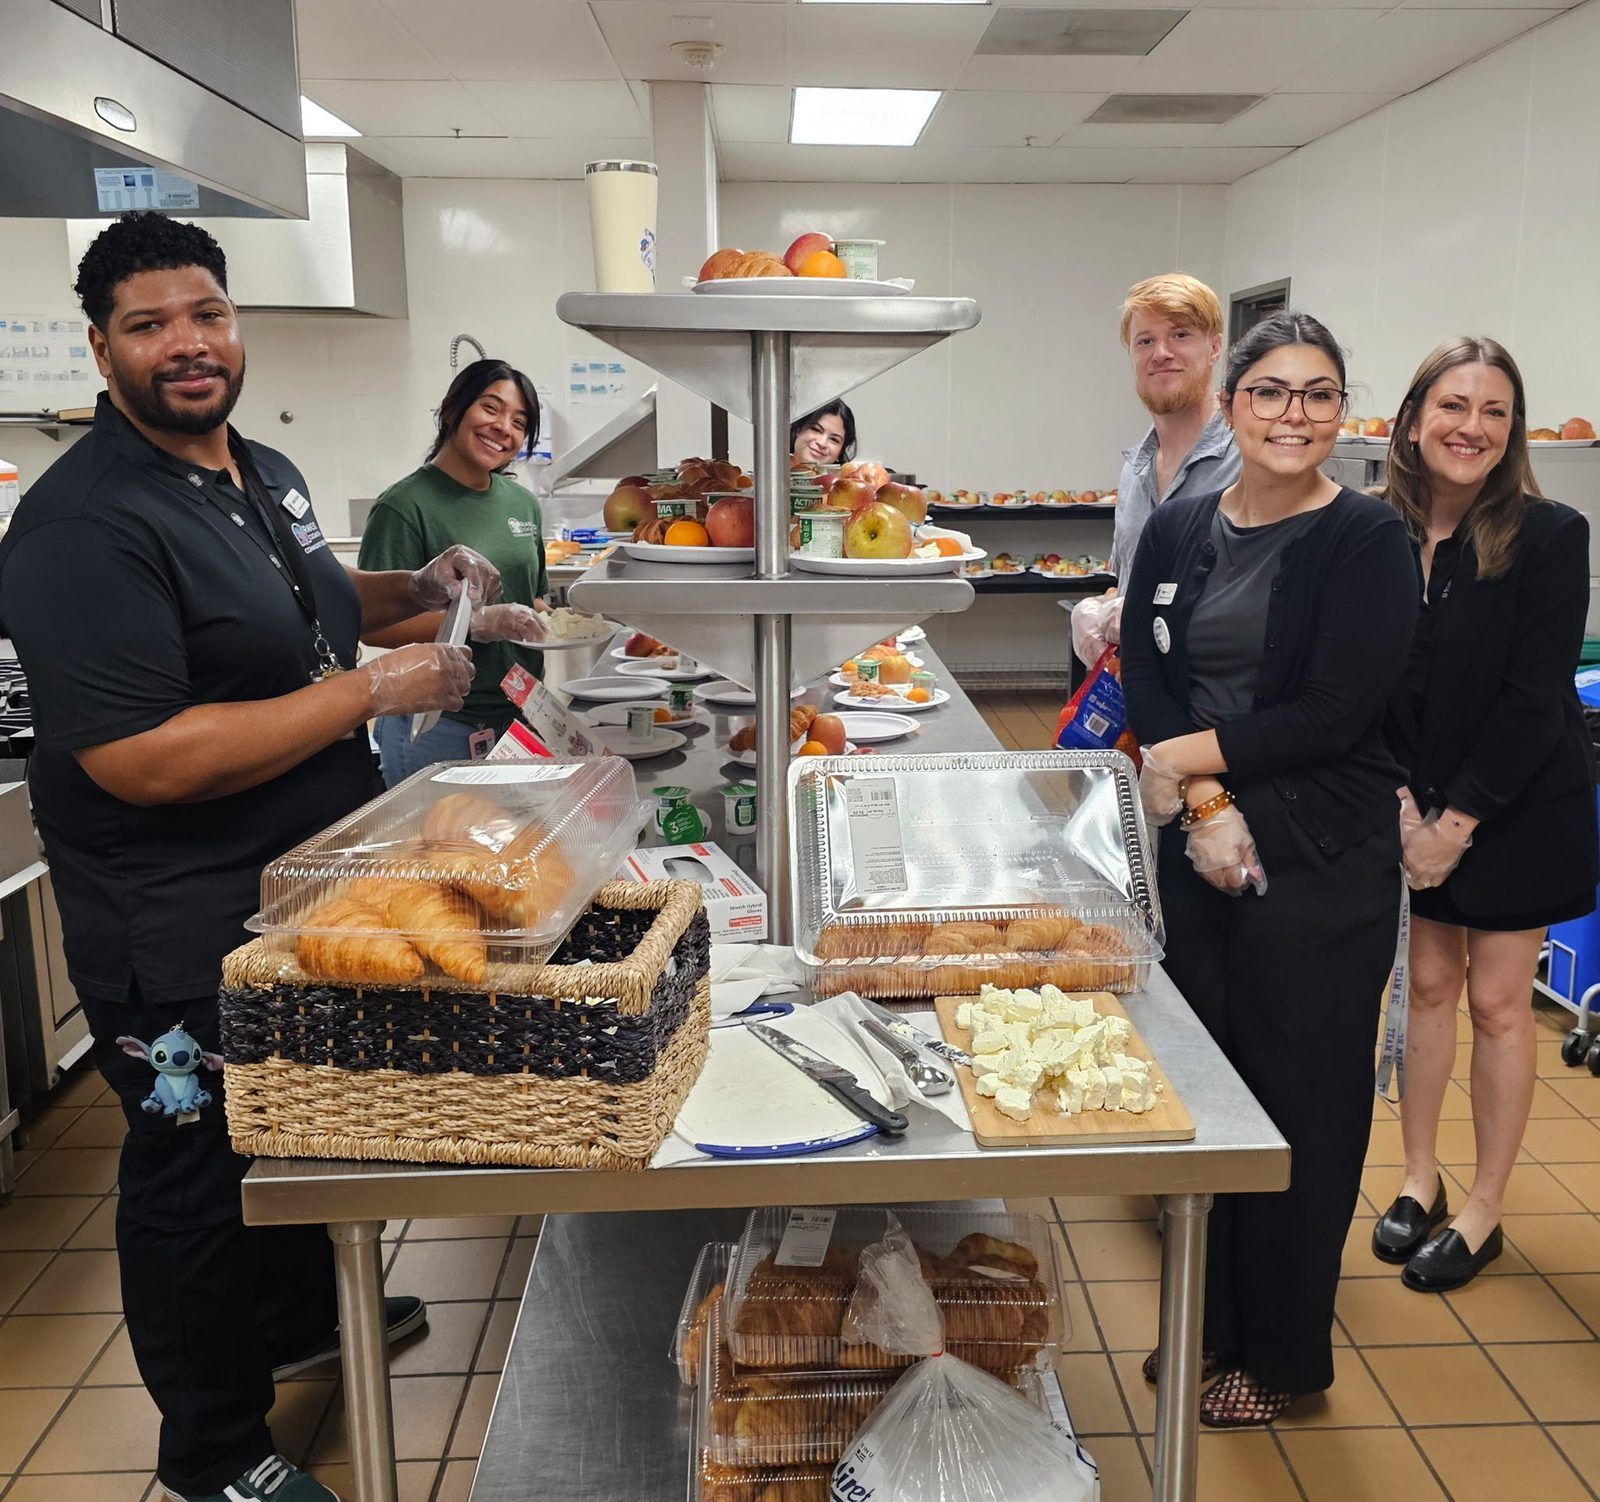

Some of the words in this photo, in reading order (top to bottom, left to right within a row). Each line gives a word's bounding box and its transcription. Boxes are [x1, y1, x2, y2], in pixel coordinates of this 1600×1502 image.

[670, 821, 679, 834] 3
[1400, 931, 1407, 943] RC
[1393, 966, 1404, 990] TEAM
[1391, 993, 1401, 1006] RC
[1384, 1027, 1396, 1052] TEAM
